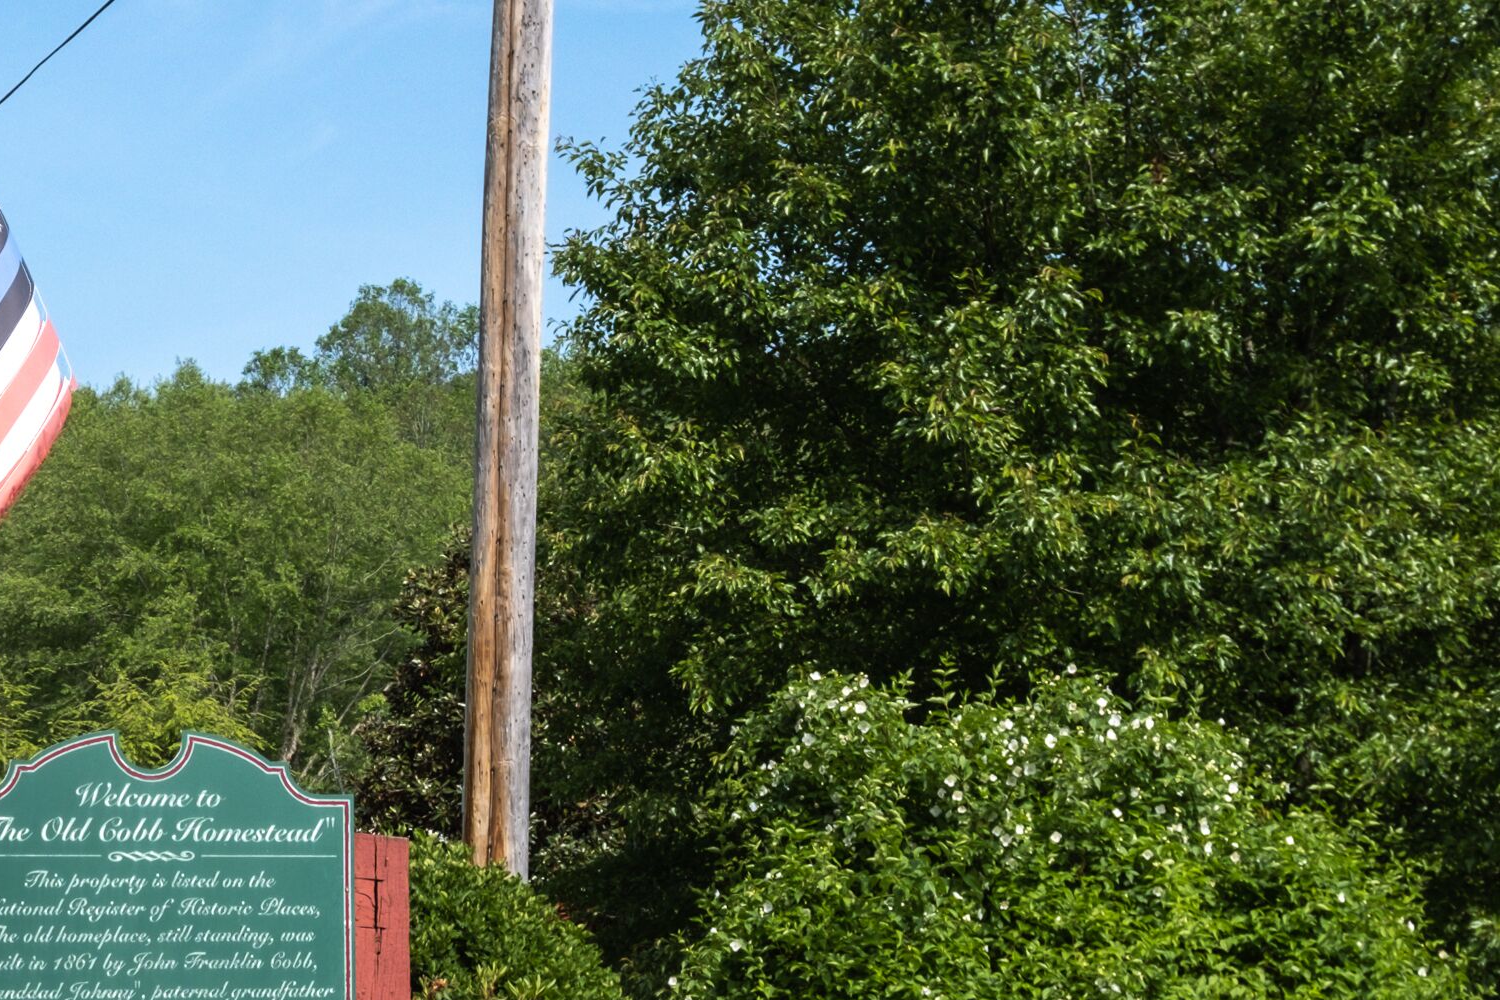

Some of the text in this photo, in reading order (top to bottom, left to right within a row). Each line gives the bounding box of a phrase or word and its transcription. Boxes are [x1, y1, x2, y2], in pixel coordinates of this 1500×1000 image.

[76, 782, 223, 807] Welcome to
[41, 816, 93, 841] Old
[99, 816, 166, 841] Cobb
[24, 870, 276, 895] This property is listed on the
[67, 897, 146, 922] Register
[149, 898, 175, 922] of
[178, 897, 253, 916] Historic
[257, 897, 320, 918] Places,
[23, 925, 54, 943] old
[55, 925, 151, 950] homeplace,
[157, 925, 193, 942] still
[195, 925, 274, 949] standing,
[281, 931, 315, 942] was
[28, 955, 47, 970] in
[54, 953, 97, 970] 1861
[103, 953, 125, 976] by
[127, 952, 177, 976] John
[184, 952, 264, 969] Franklin
[270, 952, 317, 973] Cobb,
